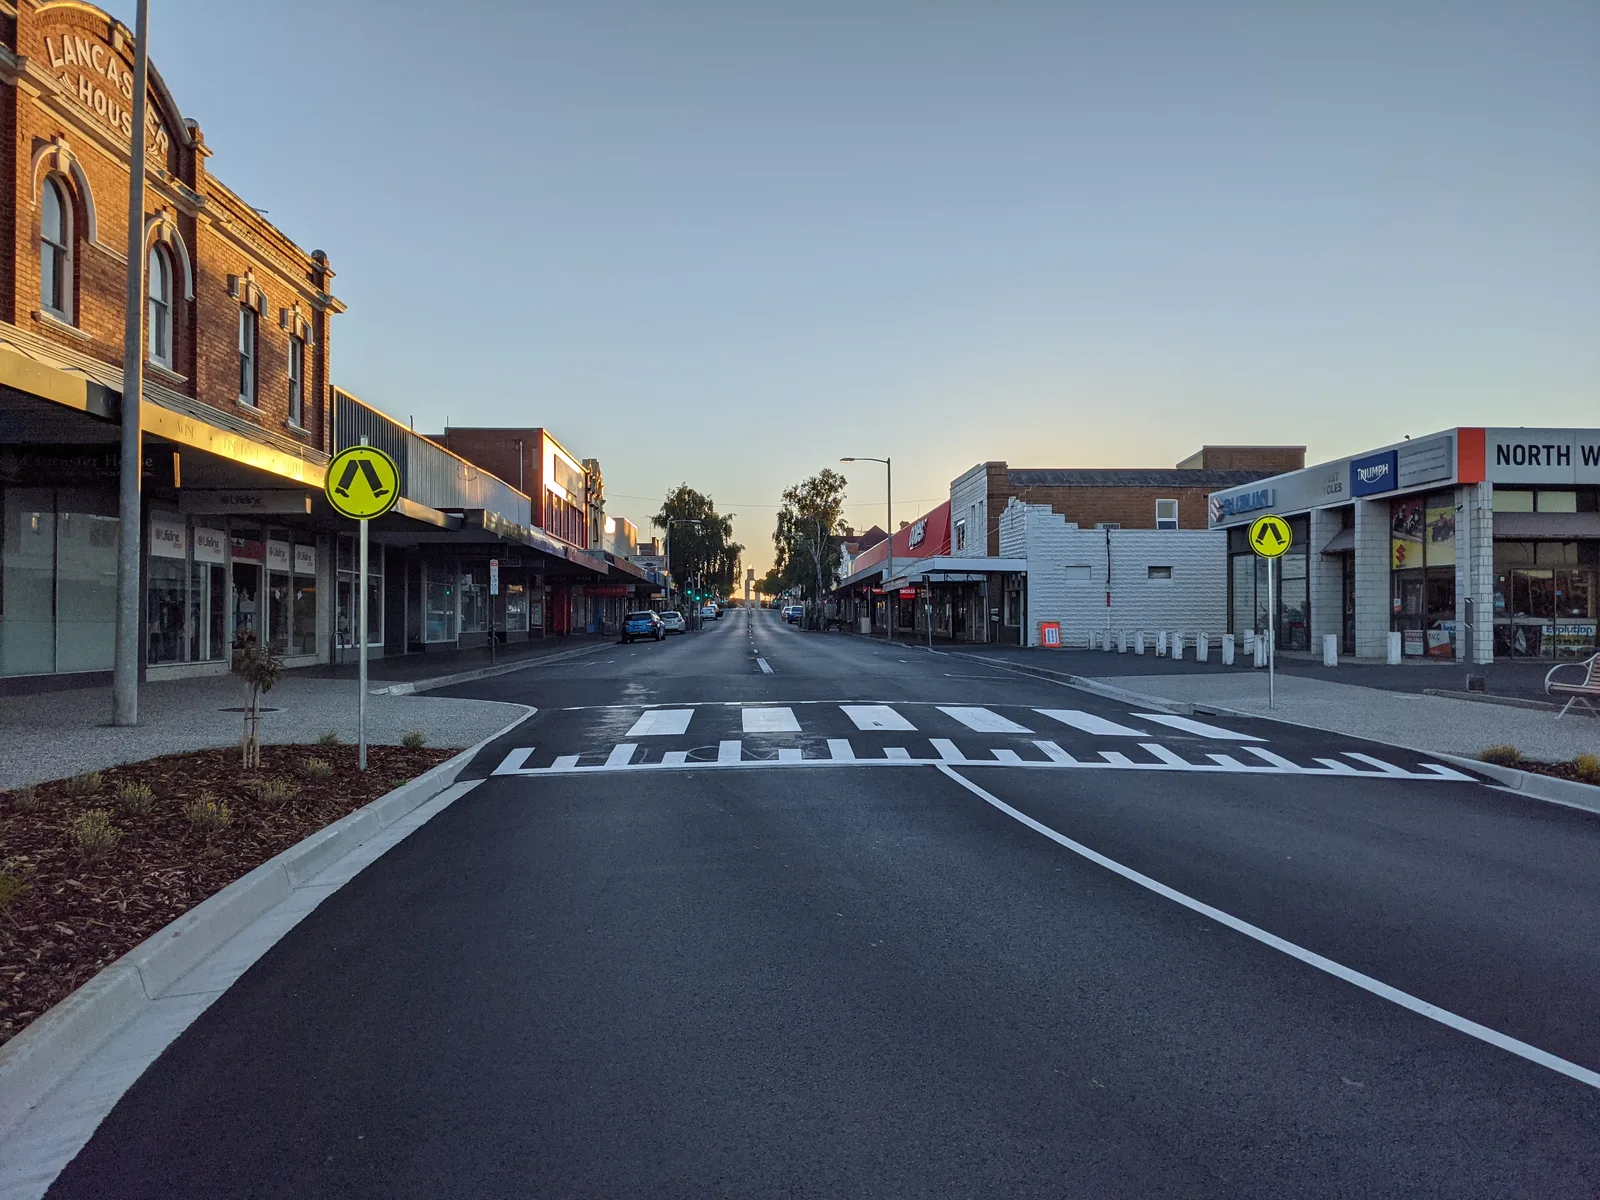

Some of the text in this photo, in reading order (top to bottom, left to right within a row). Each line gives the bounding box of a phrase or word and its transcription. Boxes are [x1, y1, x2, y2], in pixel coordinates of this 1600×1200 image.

[46, 34, 169, 155] LANCASER
[78, 74, 132, 138] HOUS
[1496, 444, 1571, 466] NORTH
[1356, 463, 1389, 483] TRIUMPH
[1222, 489, 1274, 515] SUZUKI
[161, 529, 180, 543] Lifeline
[203, 535, 220, 549] Lifeline
